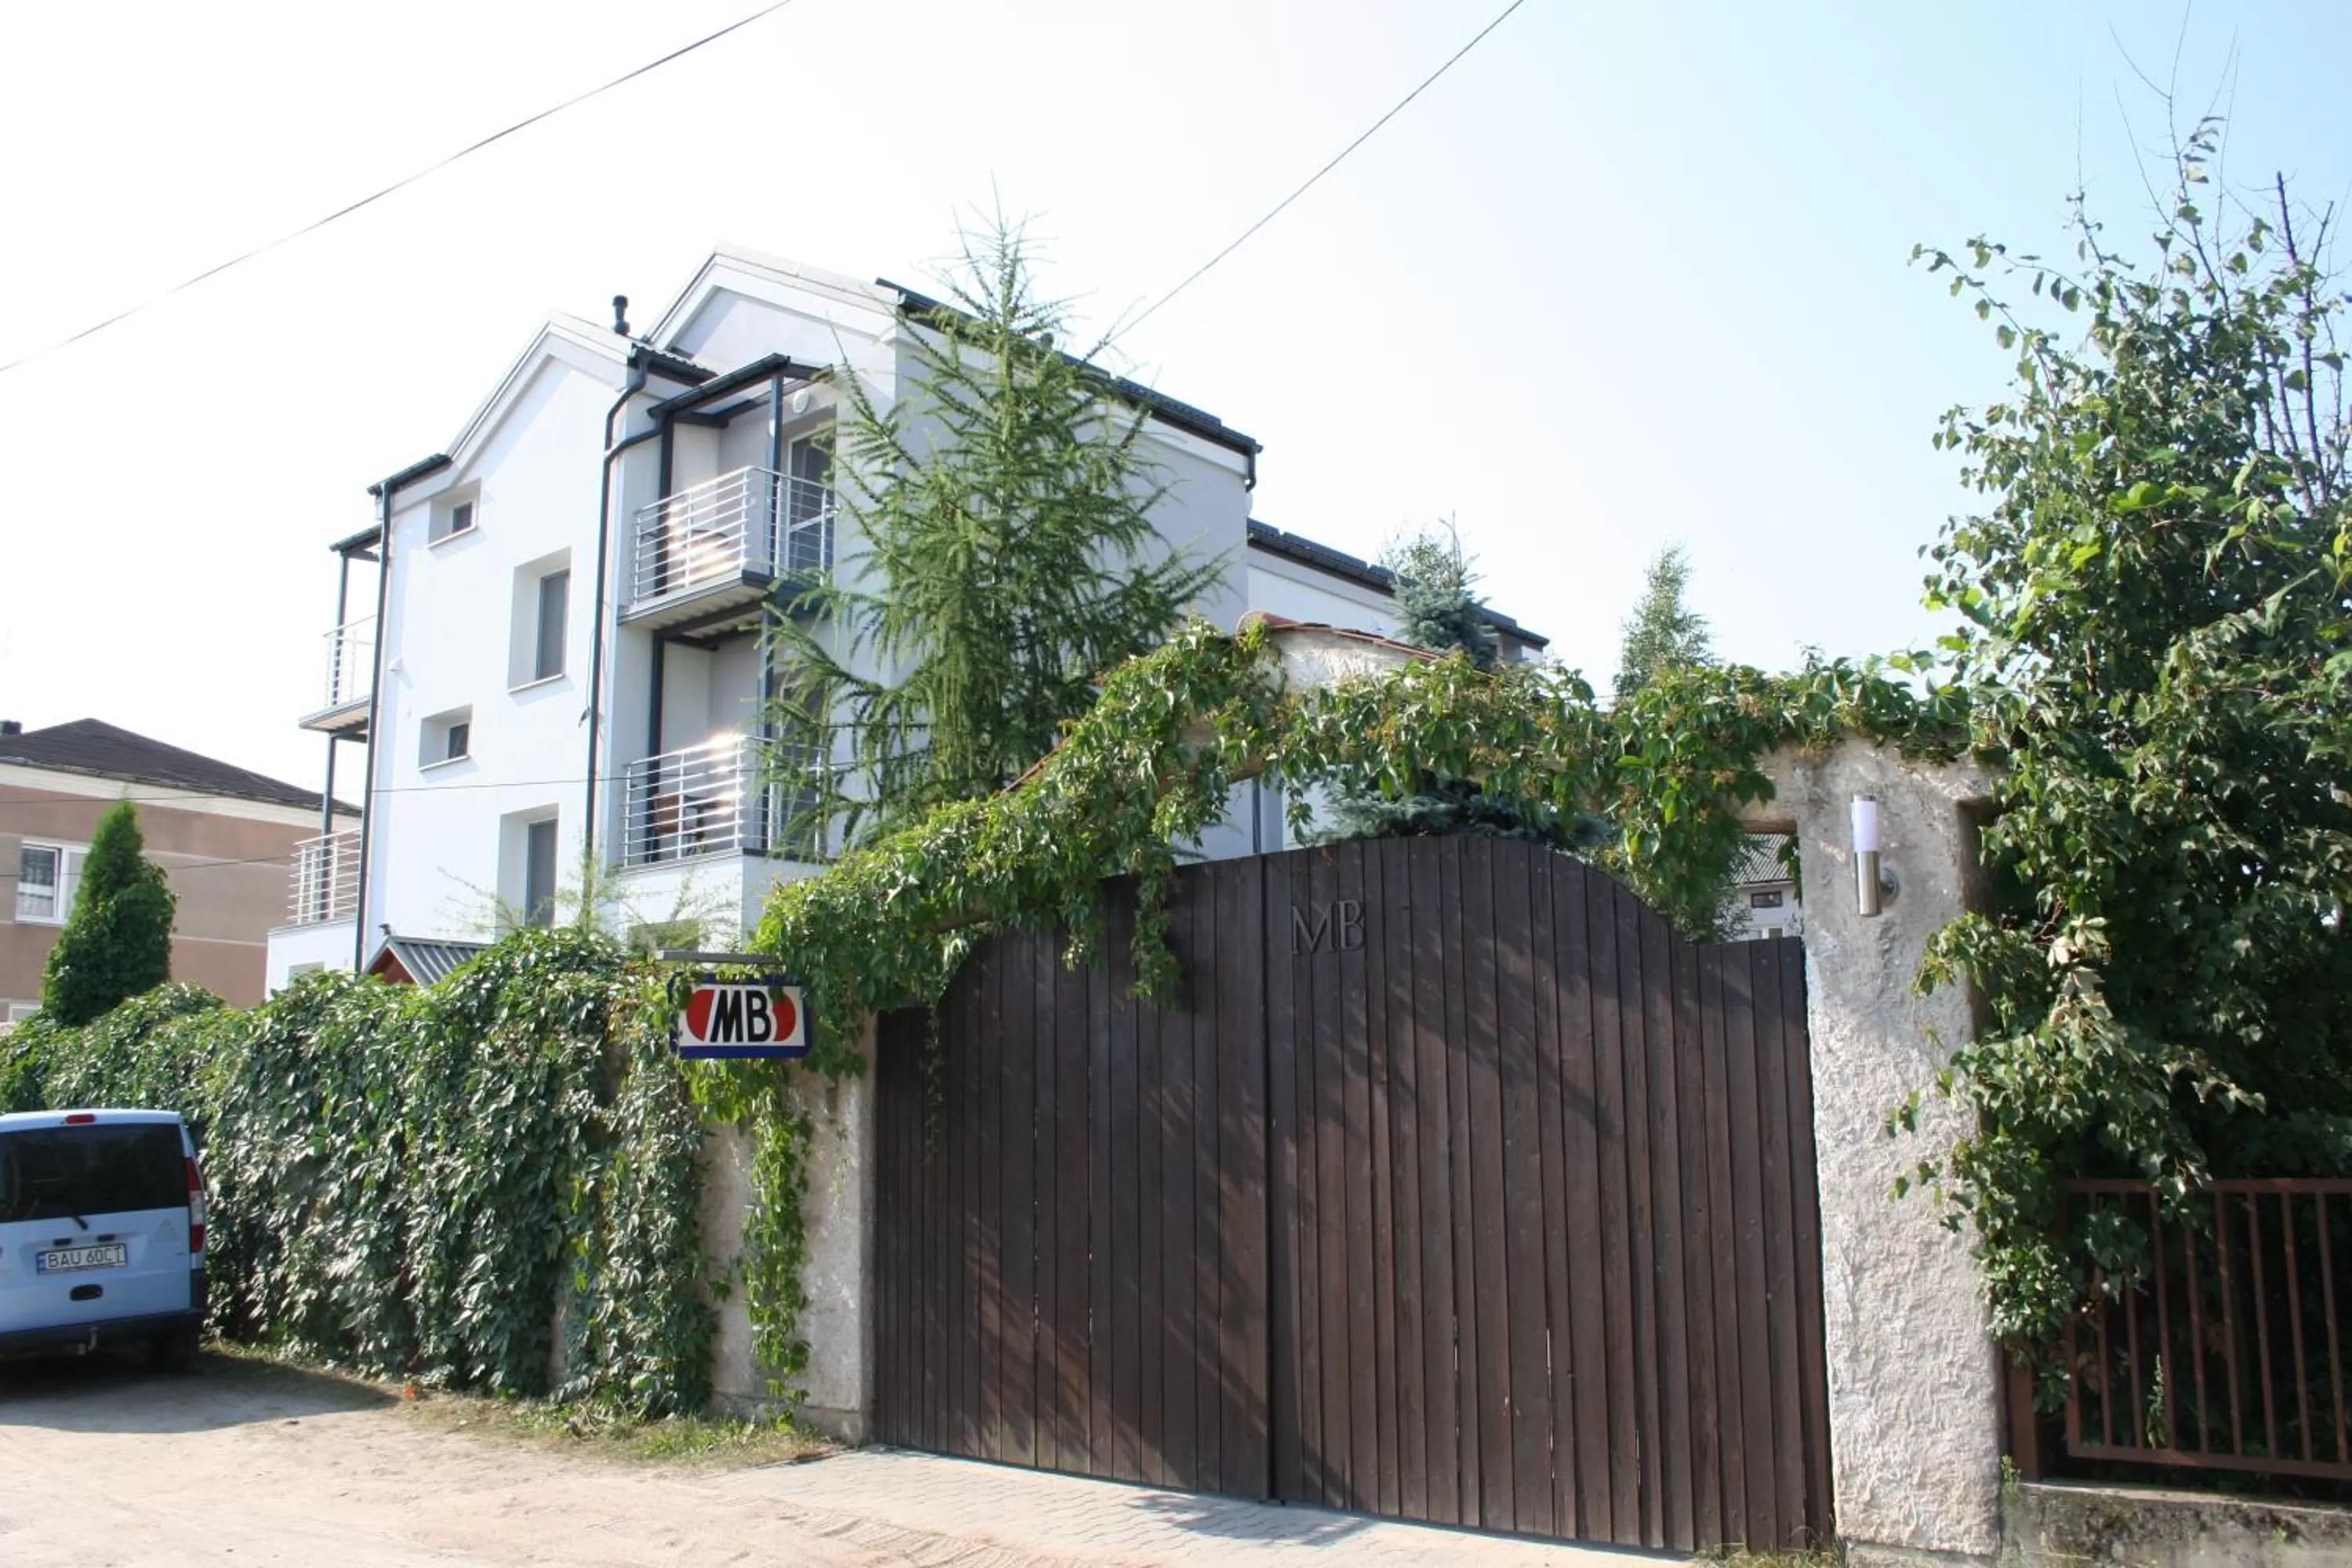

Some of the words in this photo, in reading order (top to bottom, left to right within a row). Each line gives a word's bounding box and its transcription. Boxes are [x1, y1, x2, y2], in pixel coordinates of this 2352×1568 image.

[1291, 899, 1366, 954] MB
[710, 989, 771, 1043] MB
[49, 1251, 82, 1267] BAU
